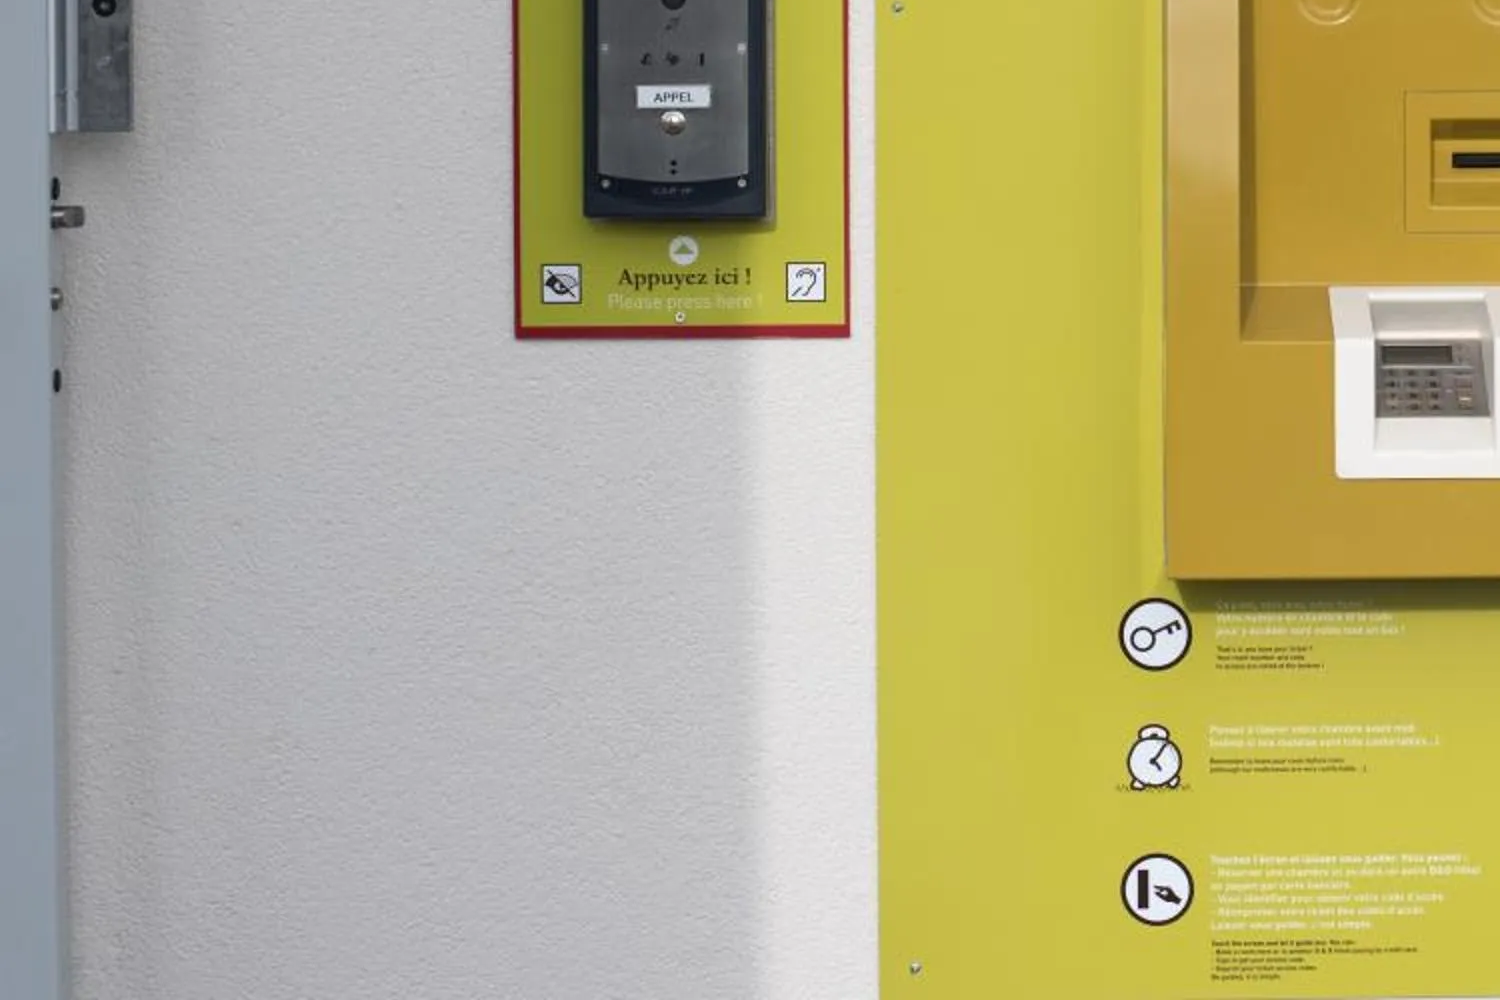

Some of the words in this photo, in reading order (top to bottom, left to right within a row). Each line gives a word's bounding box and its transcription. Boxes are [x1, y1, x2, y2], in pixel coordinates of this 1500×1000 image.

[653, 91, 694, 104] APPEL
[618, 267, 709, 290] Appuyez
[714, 266, 739, 285] ici
[744, 266, 751, 285] !
[607, 293, 663, 309] Please
